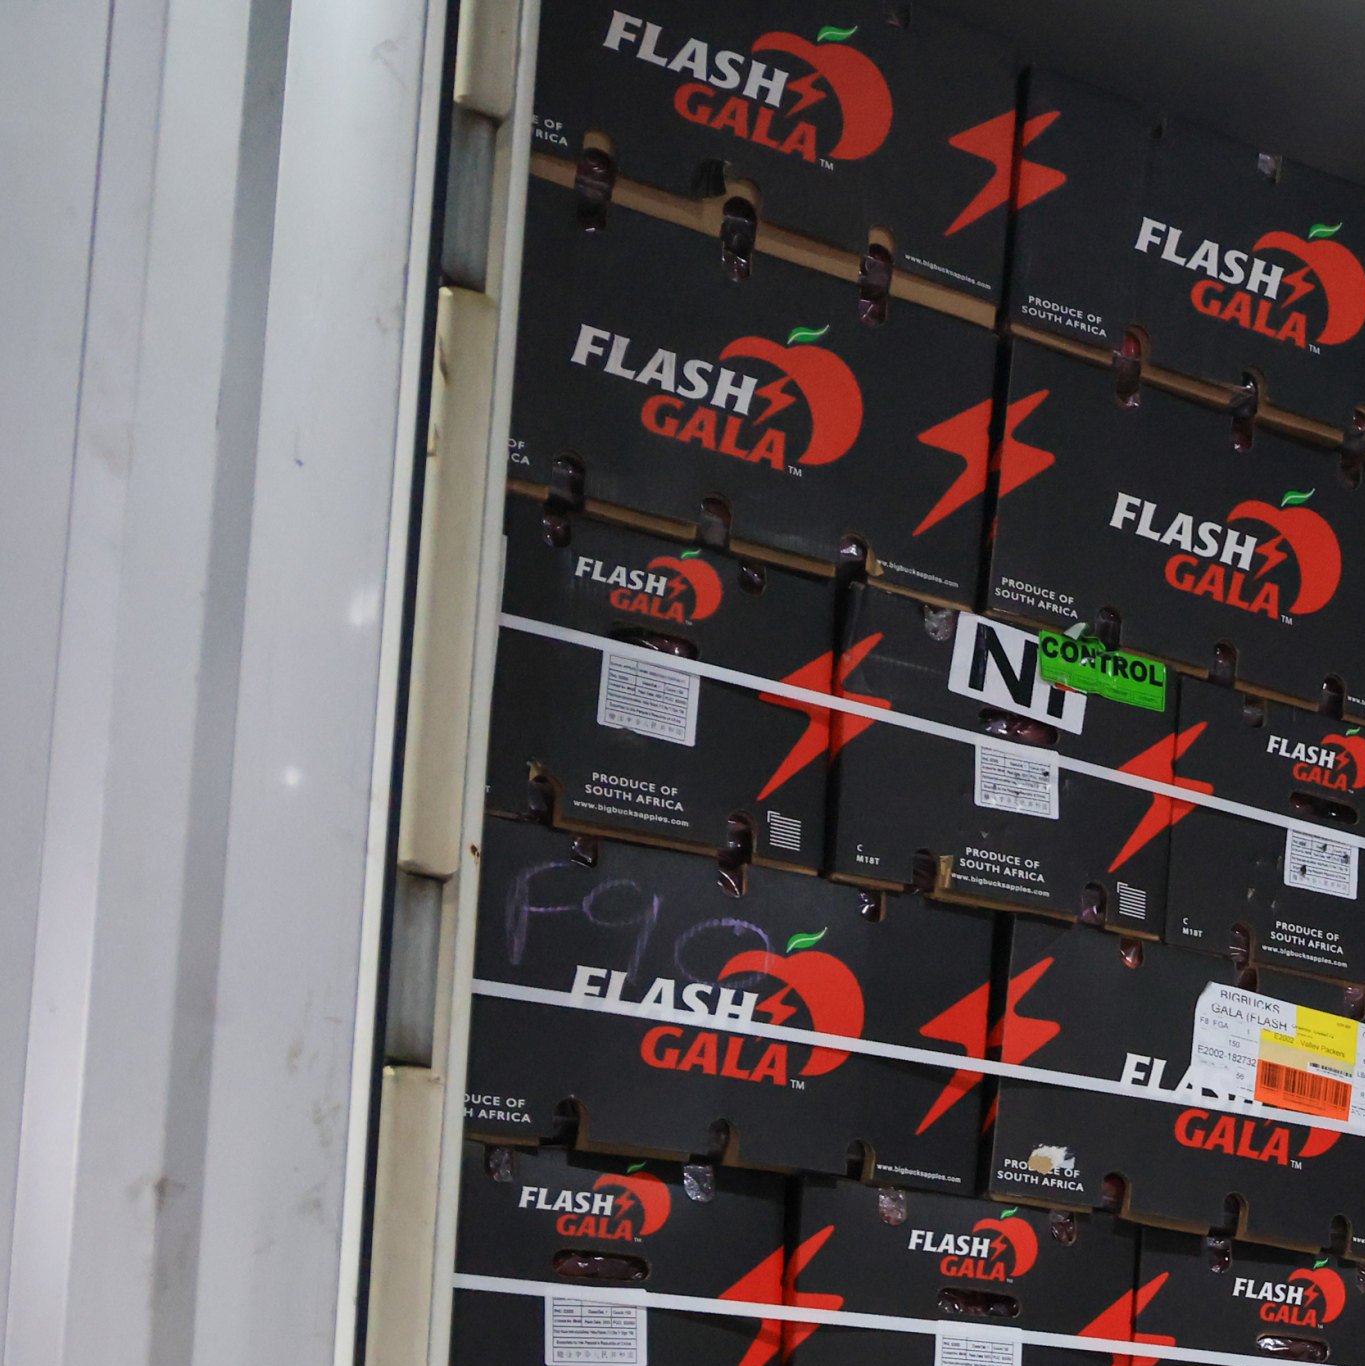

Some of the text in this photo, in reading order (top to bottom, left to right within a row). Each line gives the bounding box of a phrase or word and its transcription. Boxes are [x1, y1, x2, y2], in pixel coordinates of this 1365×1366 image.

[603, 9, 790, 108] FLASH
[673, 82, 816, 163] GALA
[1134, 216, 1285, 301] FLASH
[1021, 305, 1108, 338] SOUTH AFRICA
[1028, 294, 1103, 325] PRODUCE OF
[1190, 278, 1306, 348] GALA
[570, 323, 759, 416] FLASH
[640, 394, 787, 471] GALA
[1109, 491, 1257, 572] FLASH
[574, 556, 668, 596] FLASH
[1164, 553, 1281, 620] GALA
[610, 588, 686, 624] GALA
[1040, 634, 1163, 688] CONTROL
[1267, 735, 1336, 769] FLASH
[591, 772, 679, 796] PRODUCE OF
[1293, 760, 1348, 792] GALA
[584, 783, 684, 813] SOUTH AFRICA
[1212, 1004, 1242, 1019] GALA
[640, 1026, 787, 1086] GALA
[519, 1186, 615, 1215] FLASH
[556, 1214, 633, 1241] GALA
[908, 1230, 990, 1258] FLASH
[940, 1256, 1006, 1280] GALA
[1233, 1278, 1304, 1306] FLASH
[1259, 1304, 1317, 1327] GALA
